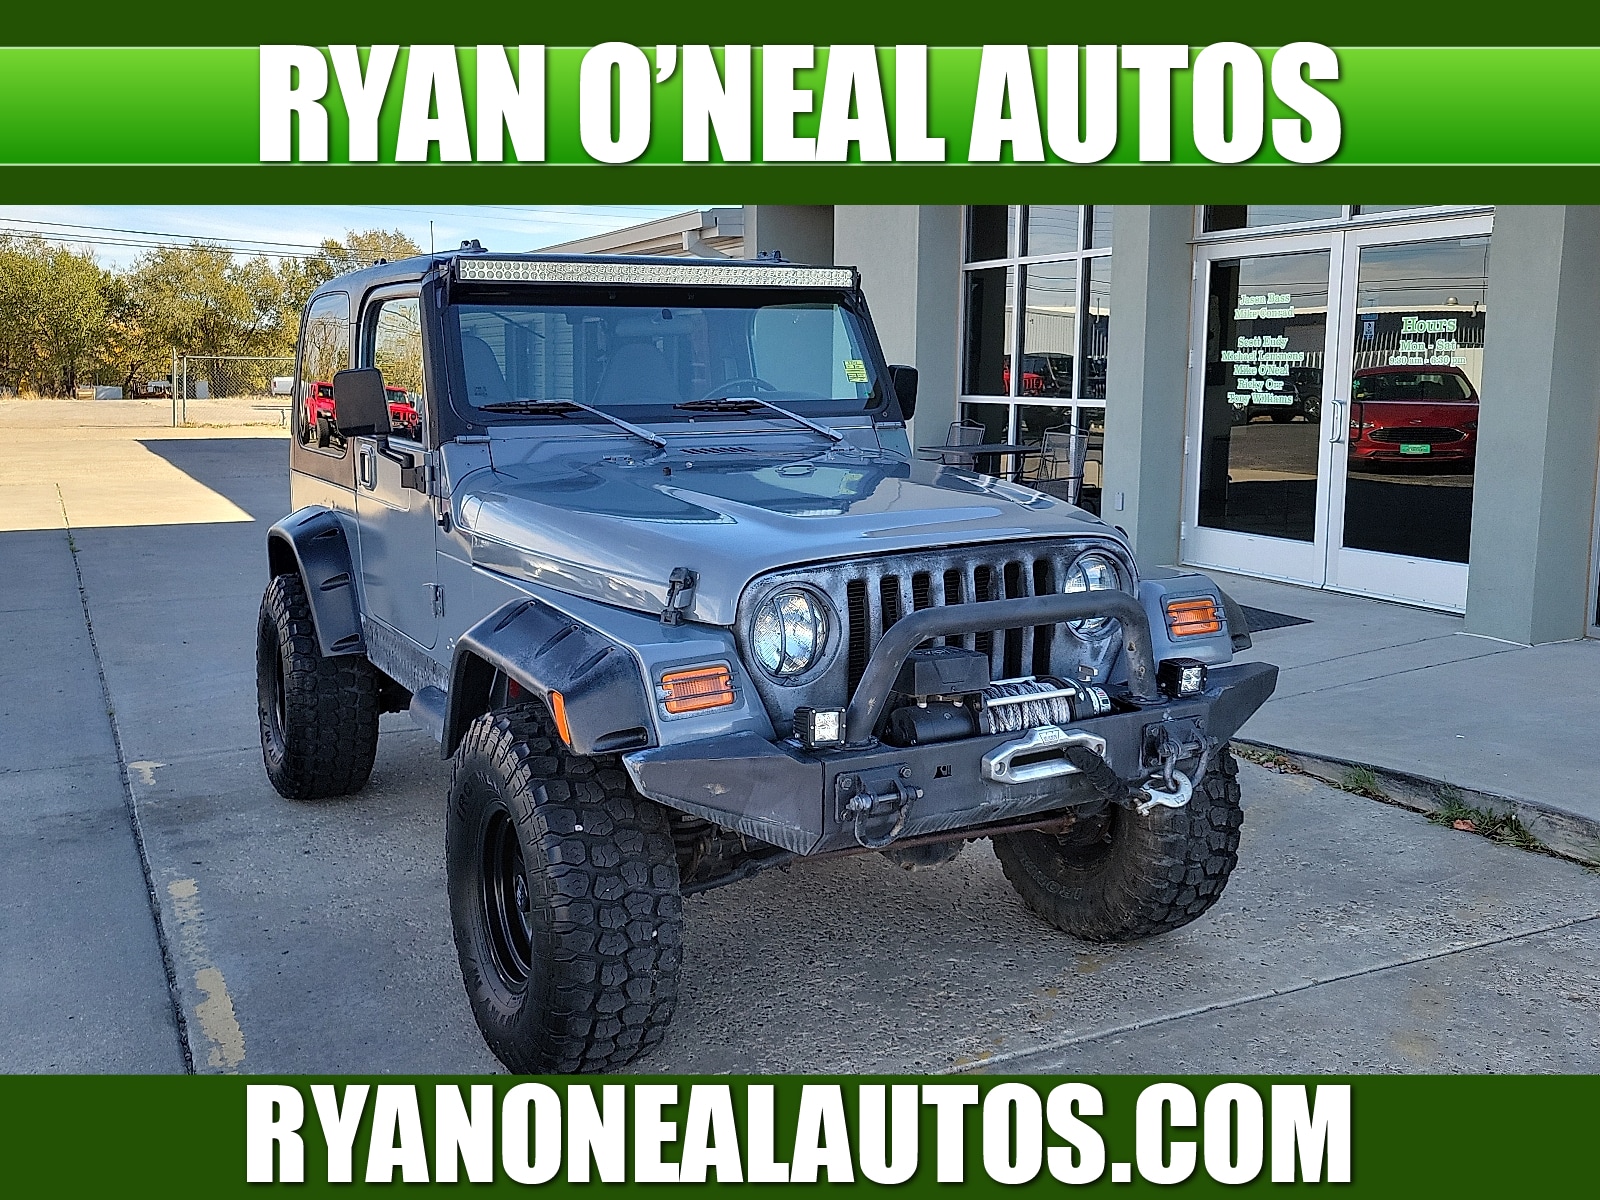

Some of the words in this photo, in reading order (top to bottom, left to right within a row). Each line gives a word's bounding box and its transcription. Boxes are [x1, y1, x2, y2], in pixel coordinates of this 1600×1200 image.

[1240, 294, 1266, 305] Jason
[1267, 293, 1290, 304] Bass
[1234, 308, 1258, 319] Mike
[1260, 306, 1294, 318] Conrad
[1402, 316, 1457, 333] Hours
[1238, 336, 1262, 347] Scott
[1400, 340, 1425, 352] Mon
[1436, 339, 1456, 351] Sat
[1221, 350, 1257, 361] Michael
[1258, 350, 1304, 361] Lemmons
[1408, 357, 1423, 365] am
[1451, 357, 1466, 367] pm
[1233, 365, 1257, 375] Mike
[1237, 378, 1264, 392] Ricky
[1265, 378, 1284, 390] Orr
[1227, 392, 1251, 406] Tony
[1251, 393, 1293, 405] Williams
